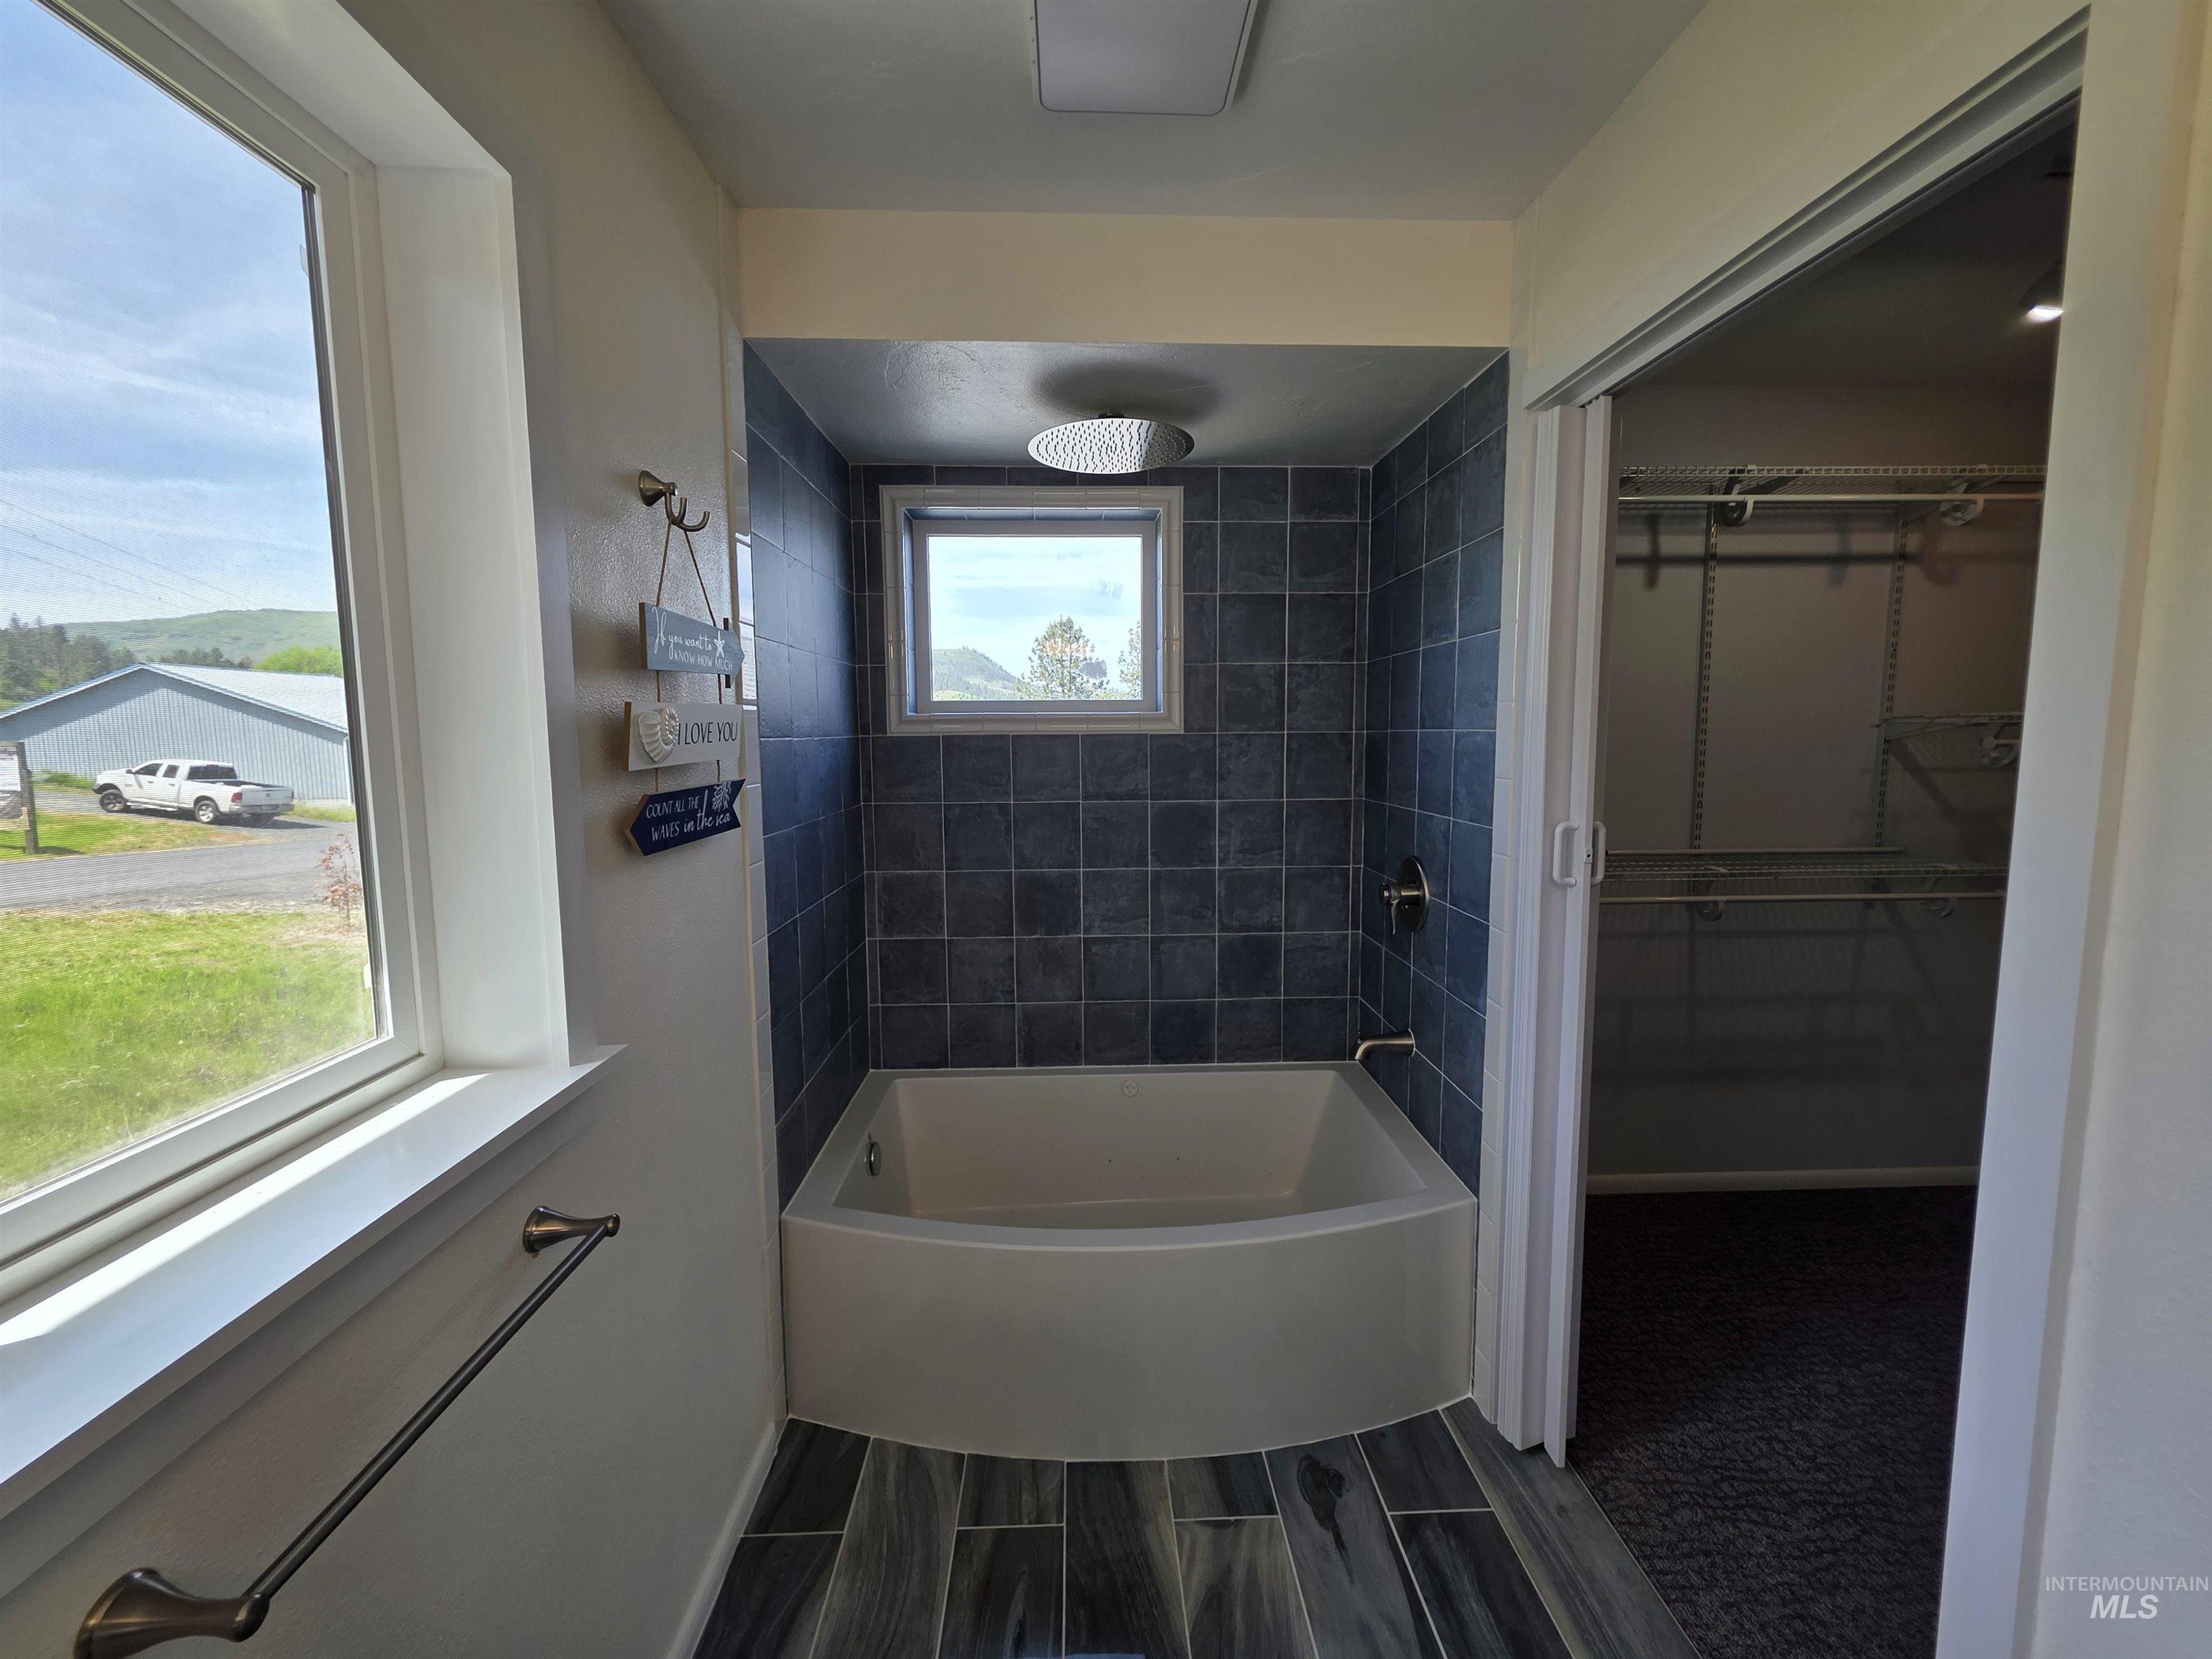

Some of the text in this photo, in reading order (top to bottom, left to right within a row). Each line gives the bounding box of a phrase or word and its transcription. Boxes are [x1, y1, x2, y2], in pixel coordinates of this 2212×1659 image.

[668, 634, 683, 660] you
[685, 634, 703, 649] want
[703, 634, 712, 651] to
[674, 649, 733, 671] KNOW HOW MUCH
[678, 721, 738, 745] I LOVE YOU
[647, 796, 701, 818] COUNT ALL THE
[652, 789, 732, 841] WAVES in the sea
